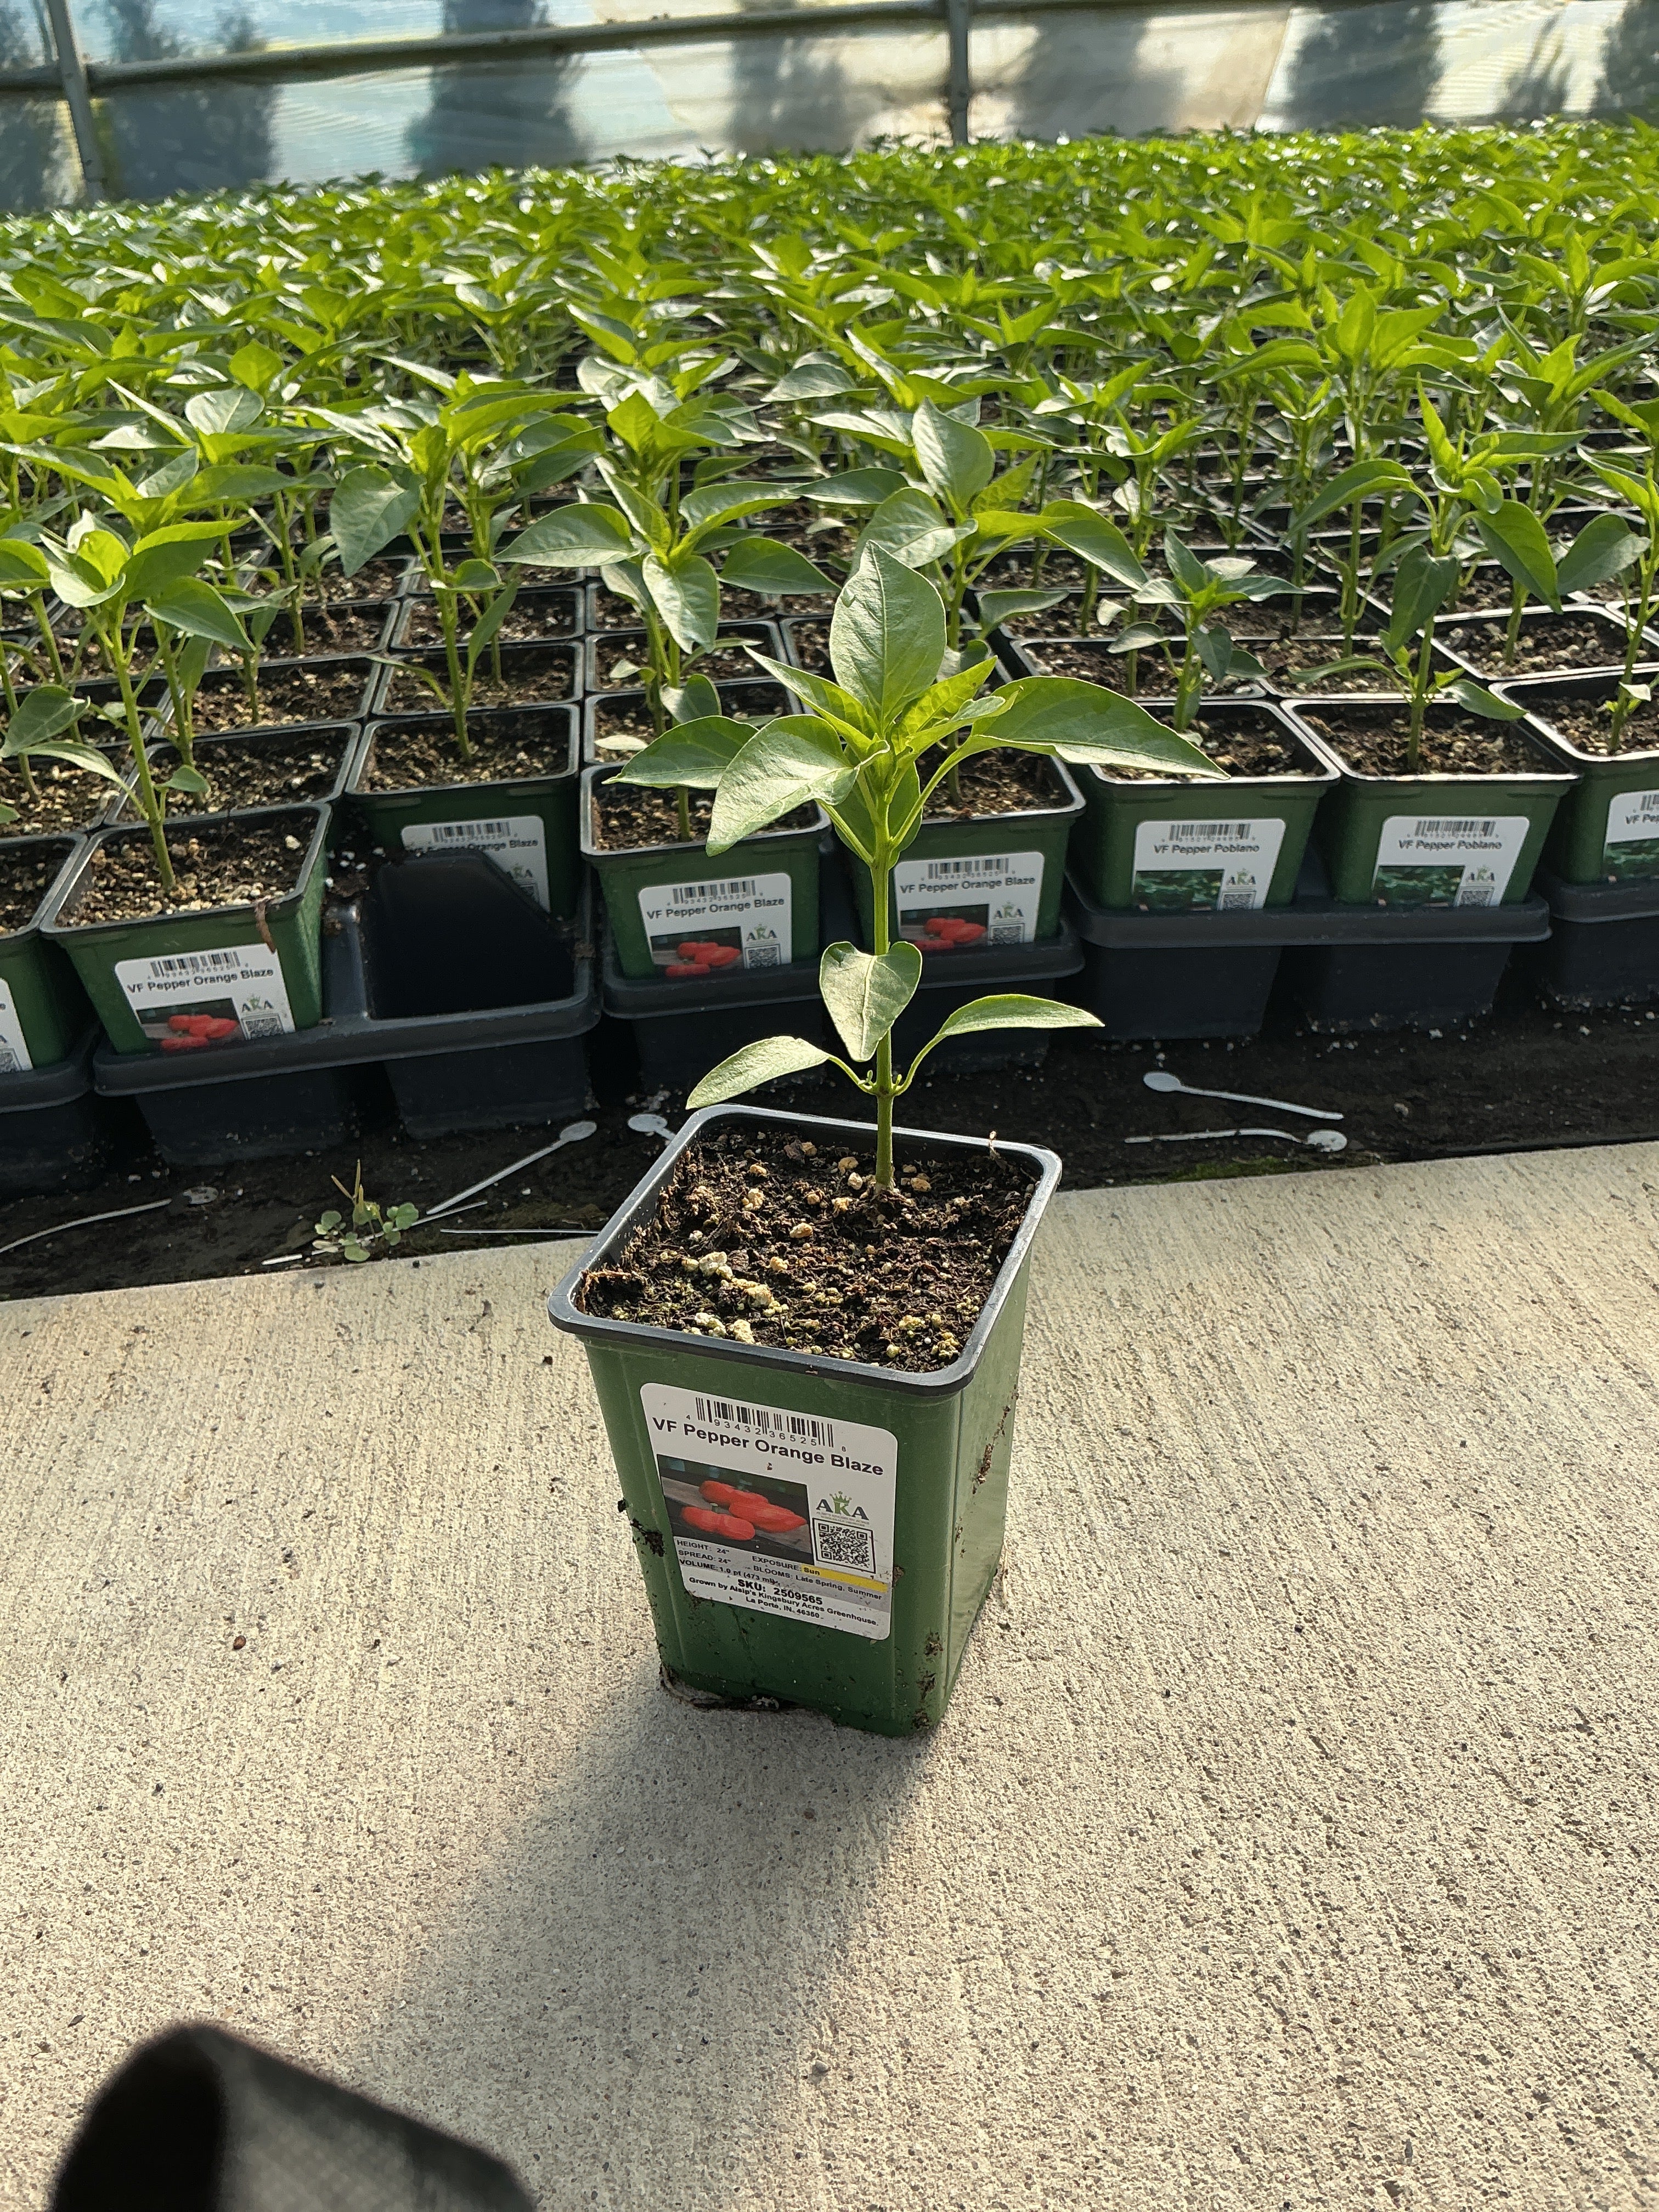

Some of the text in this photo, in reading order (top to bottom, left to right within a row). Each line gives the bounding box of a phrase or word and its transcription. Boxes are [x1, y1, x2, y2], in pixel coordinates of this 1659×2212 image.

[509, 839, 539, 848] Blaze
[1154, 844, 1260, 855] VF Pepper Poblano
[1398, 839, 1502, 851] VF Pepper Poblano
[900, 876, 1035, 894] VF Pepper Orange Blaze
[646, 898, 785, 920] VF Pepper Orange Blaze
[994, 902, 1024, 919] AKA
[746, 924, 777, 941] AKA
[127, 968, 273, 994] VF Pepper Orange Blaze
[241, 995, 273, 1012] AKA
[714, 1419, 761, 1435] 93432
[769, 1430, 817, 1446] 36525
[652, 1417, 884, 1475] VF Pepper Orange Blaze
[816, 1492, 870, 1521] AKA
[677, 1540, 712, 1551] HEIGHT:
[678, 1550, 716, 1562] SPREAD:
[679, 1559, 719, 1571] VOLUME:
[743, 1572, 760, 1581] (473
[752, 1556, 820, 1576] EXPOSURE: Sun
[738, 1578, 823, 1605] SKU: 2509565
[753, 1565, 882, 1600] BLOOMS: Late Spring, Summer
[689, 1577, 715, 1587] Grown
[718, 1582, 727, 1590] by
[758, 1591, 800, 1608] Kingsbury
[802, 1602, 825, 1612] Acres
[746, 1596, 755, 1604] La
[758, 1599, 781, 1611] Porte,
